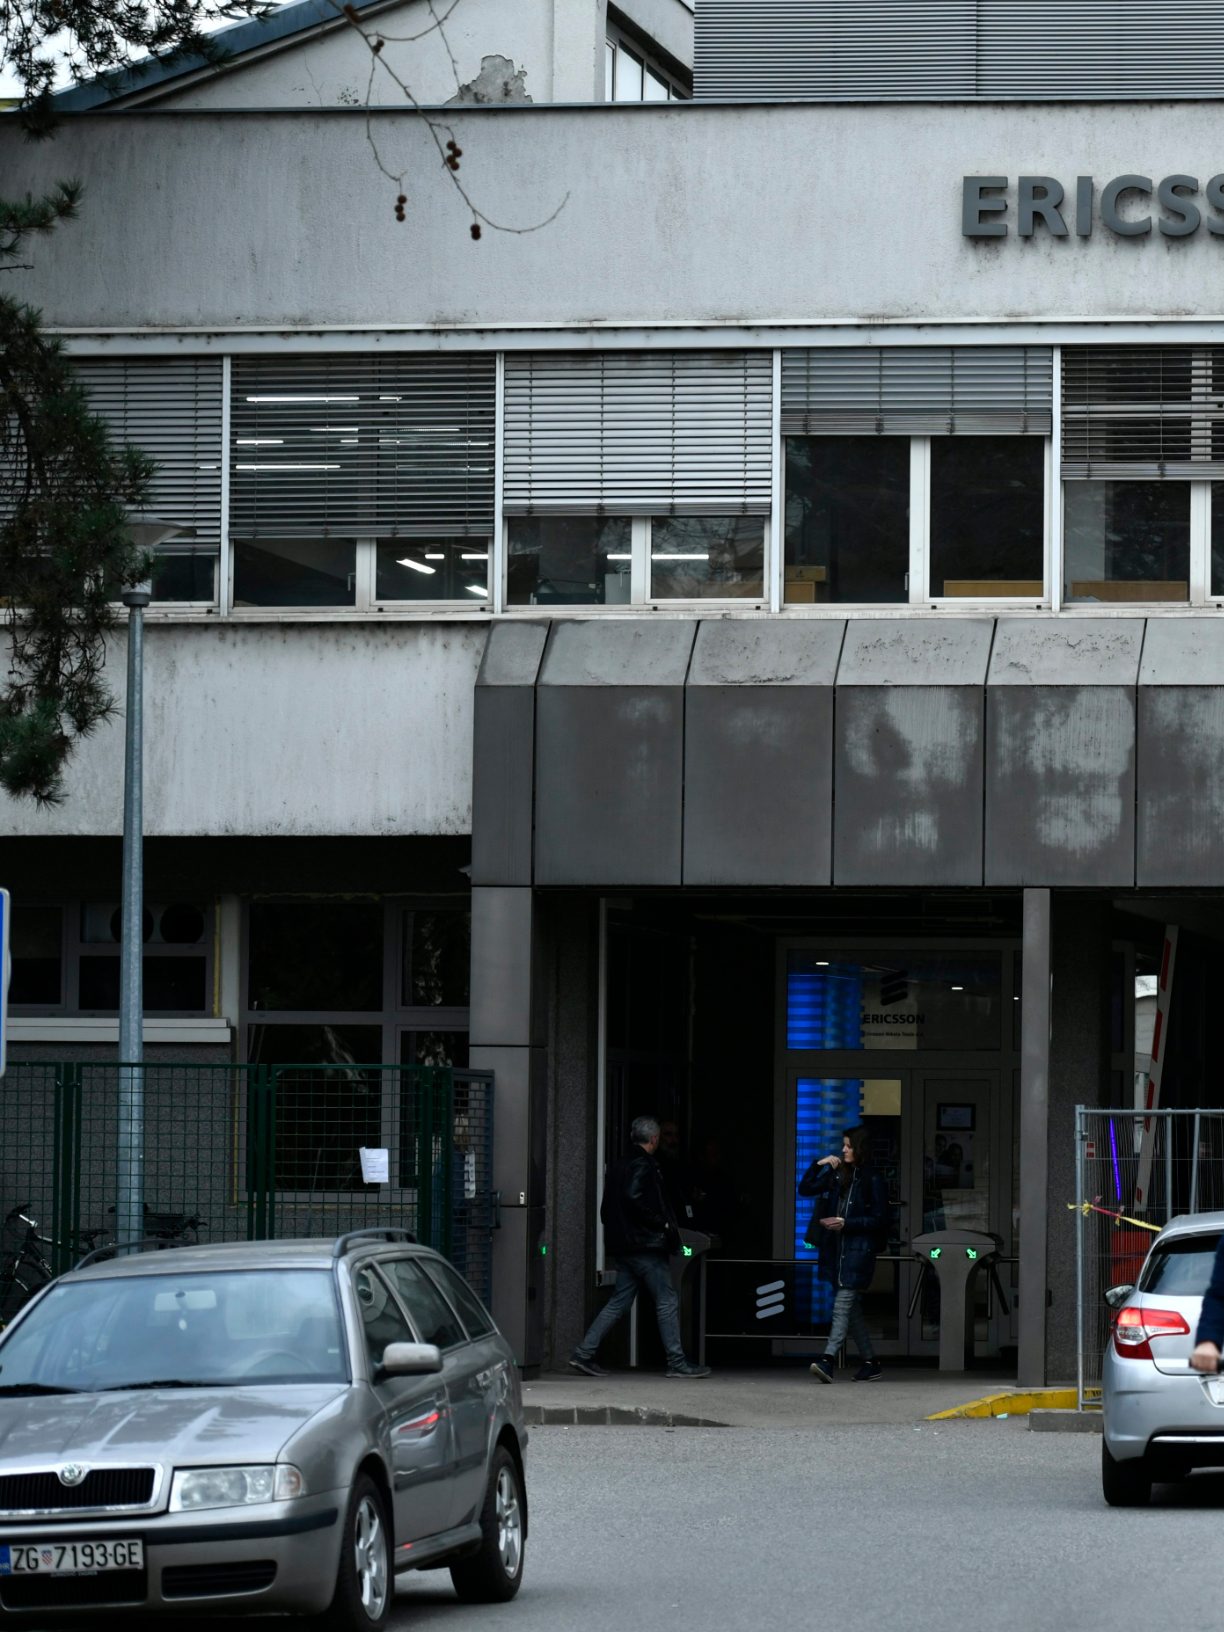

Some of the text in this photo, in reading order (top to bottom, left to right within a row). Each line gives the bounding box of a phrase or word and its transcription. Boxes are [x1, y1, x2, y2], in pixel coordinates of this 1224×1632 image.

[863, 1014, 925, 1024] ERICSSON
[12, 1547, 39, 1571] ZG
[54, 1542, 140, 1569] 7193-GE
